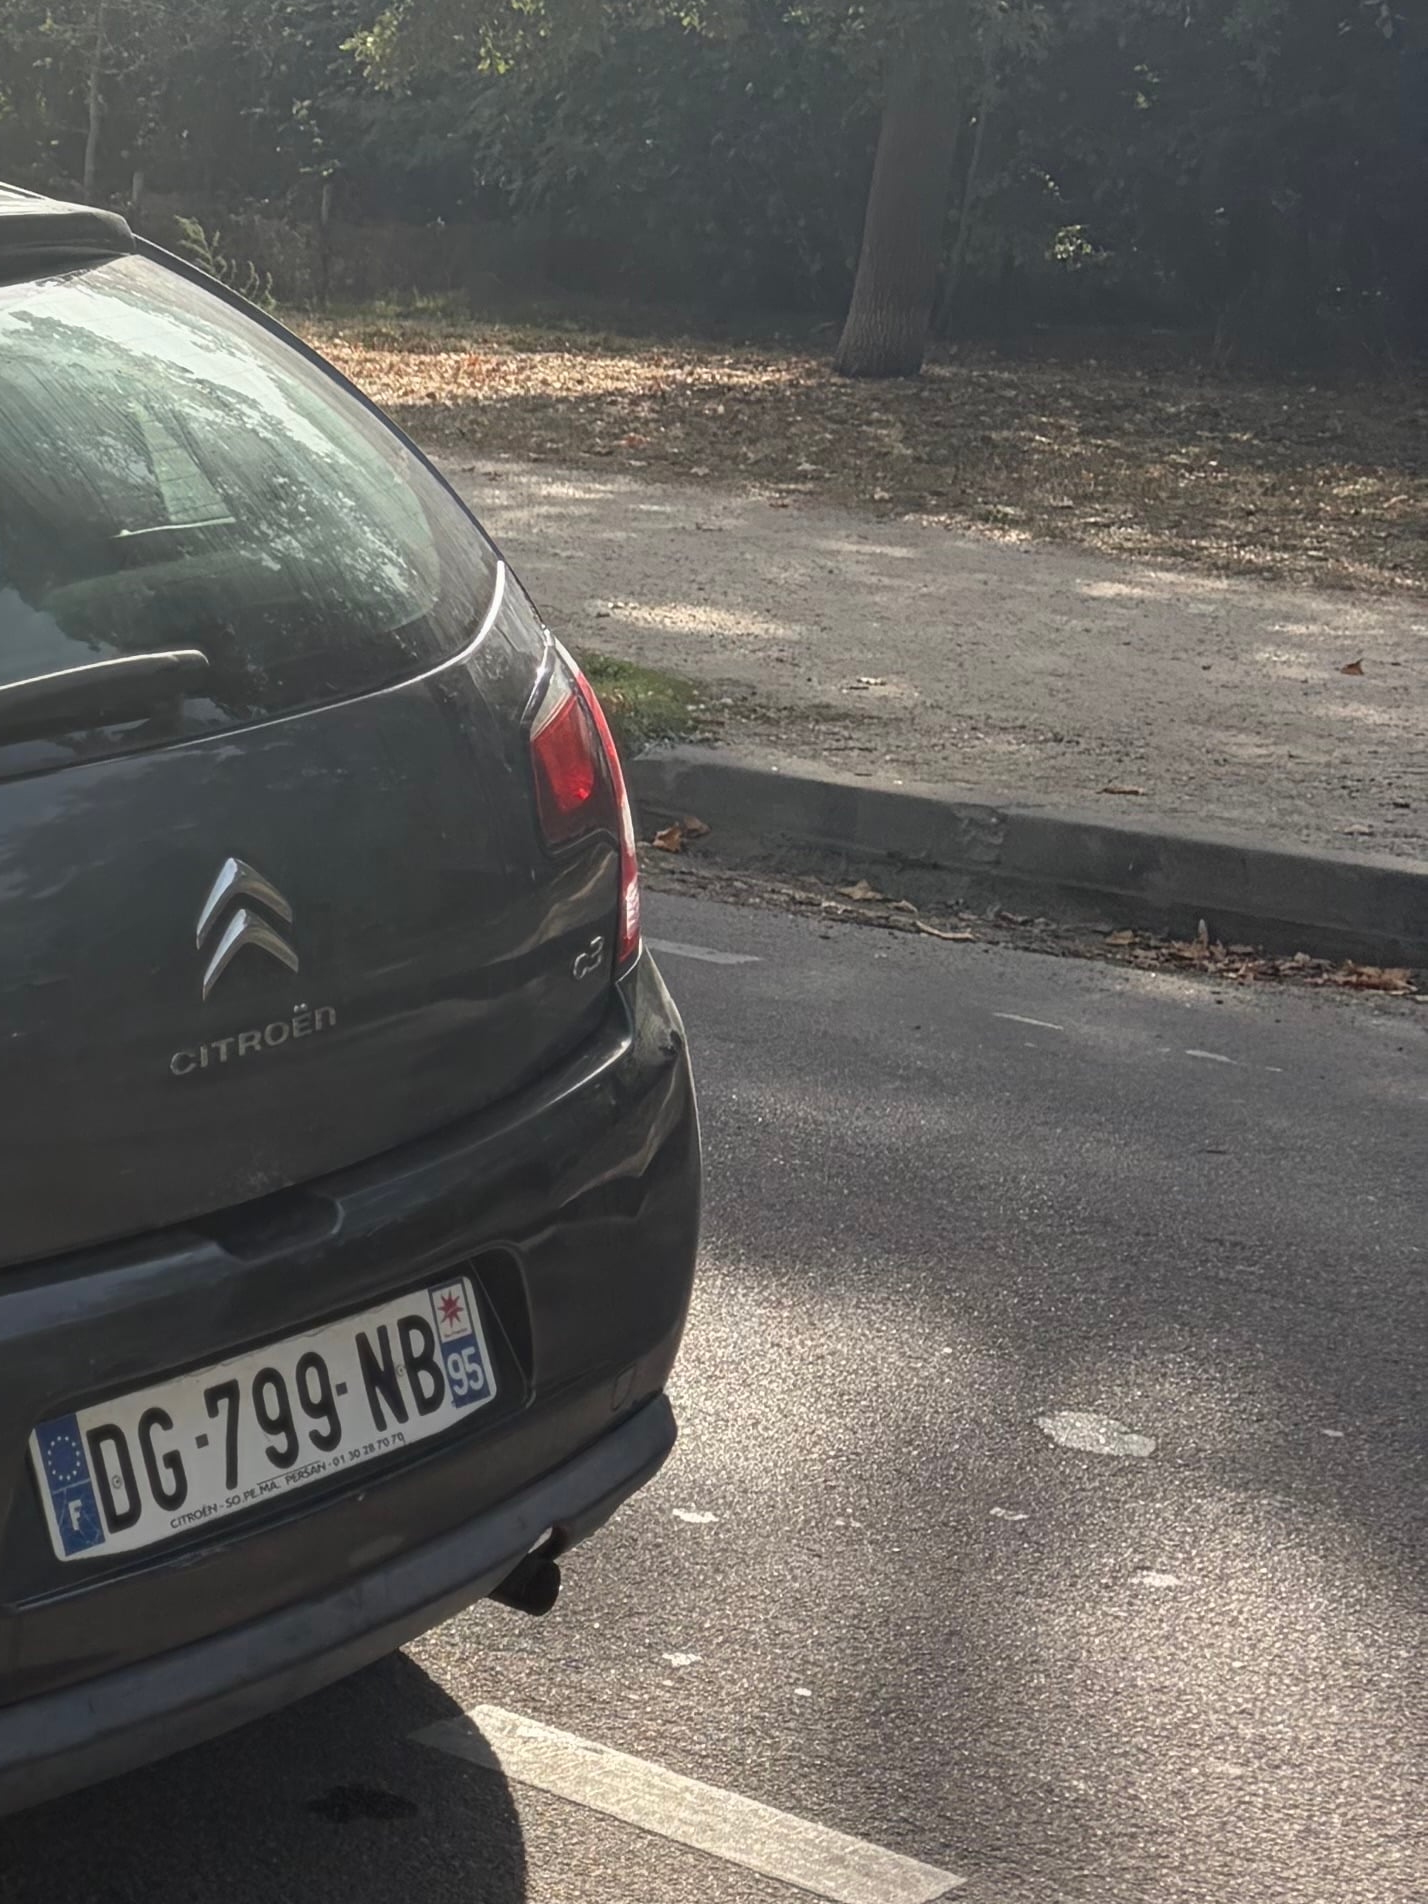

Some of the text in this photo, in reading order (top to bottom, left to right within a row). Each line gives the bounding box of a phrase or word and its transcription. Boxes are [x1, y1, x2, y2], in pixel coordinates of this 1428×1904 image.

[572, 935, 605, 981] C3
[446, 1346, 485, 1396] 95
[86, 1313, 446, 1535] DG-799-NB
[348, 1448, 361, 1462] 30
[68, 1498, 83, 1532] F
